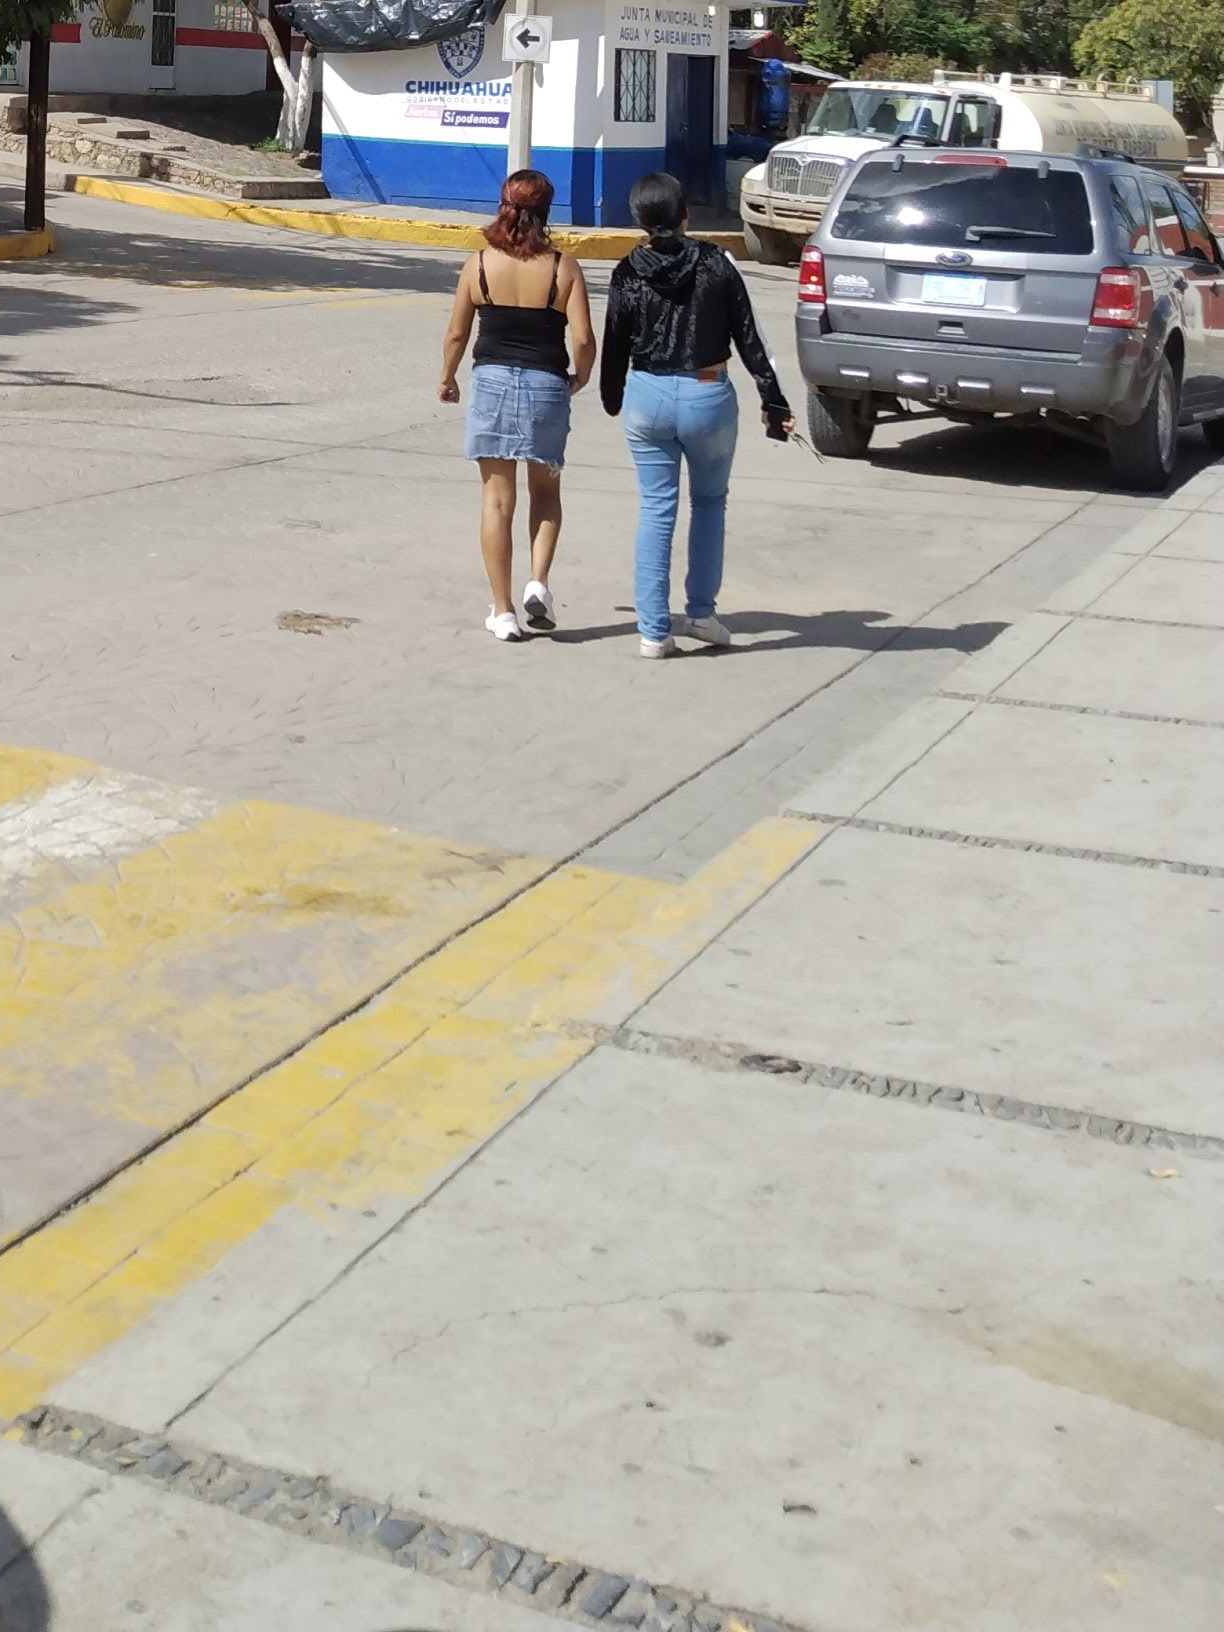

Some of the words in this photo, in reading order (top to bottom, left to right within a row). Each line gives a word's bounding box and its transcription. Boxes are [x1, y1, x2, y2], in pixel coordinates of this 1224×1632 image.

[621, 6, 650, 22] JUNTA
[655, 9, 698, 27] MUNICIPAL
[702, 14, 713, 29] DE
[619, 26, 640, 41] AGUA
[644, 28, 651, 42] Y
[653, 29, 711, 47] SANEAMIENTO
[405, 80, 512, 97] CHIHUAHUA
[473, 97, 509, 106] ESTAD
[455, 113, 501, 126] podemos
